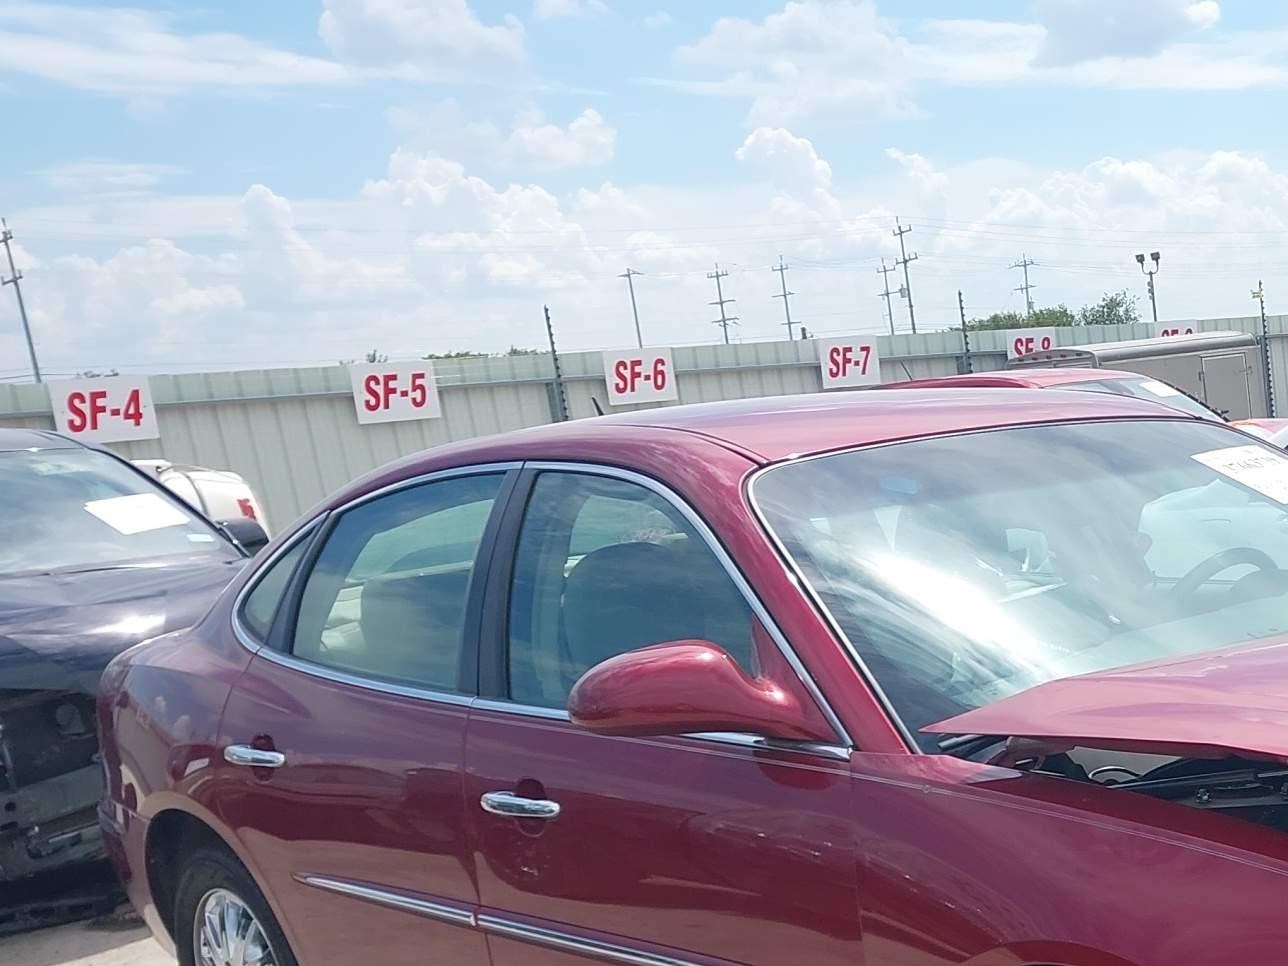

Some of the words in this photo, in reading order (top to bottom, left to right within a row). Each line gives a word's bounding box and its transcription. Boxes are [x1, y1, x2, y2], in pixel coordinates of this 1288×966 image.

[615, 358, 666, 394] SF-6
[829, 346, 870, 378] SF-7
[67, 389, 143, 432] SF-4
[364, 373, 426, 411] SF-5
